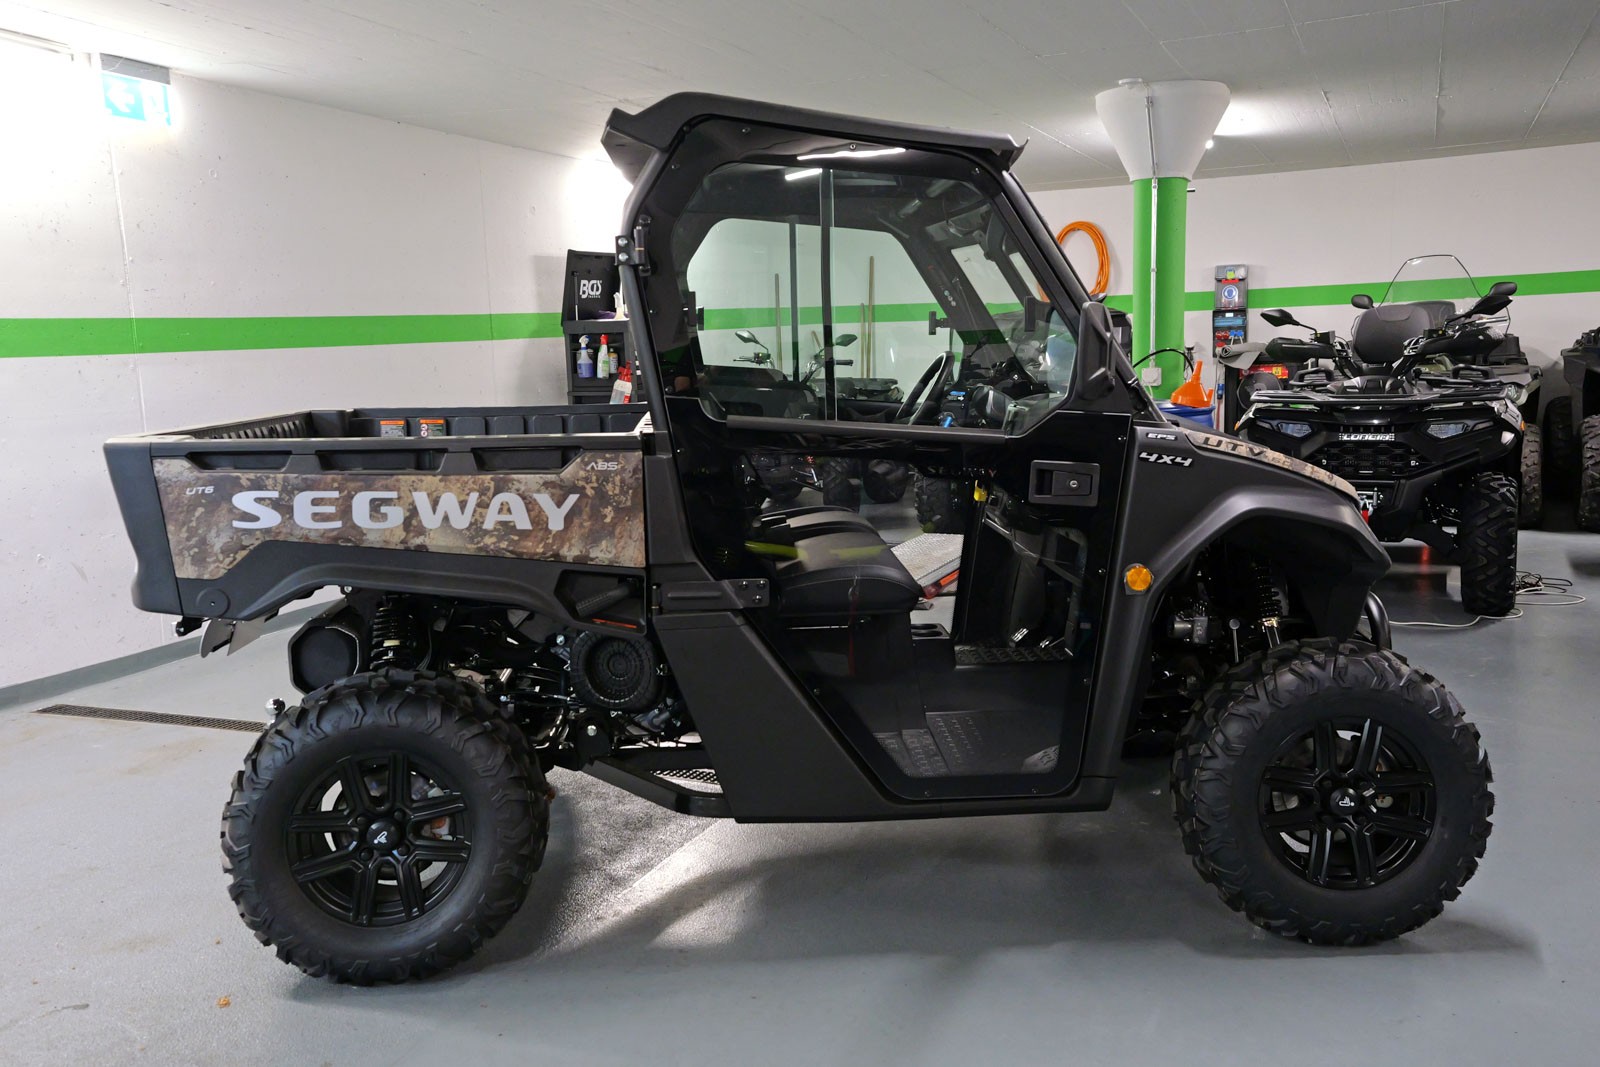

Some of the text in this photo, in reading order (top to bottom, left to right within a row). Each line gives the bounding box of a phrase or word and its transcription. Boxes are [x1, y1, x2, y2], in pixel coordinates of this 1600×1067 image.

[1147, 432, 1177, 441] EPS
[1202, 437, 1265, 456] UTV
[586, 461, 618, 471] ABS
[186, 485, 215, 495] UT6
[231, 490, 580, 531] SEGWAY
